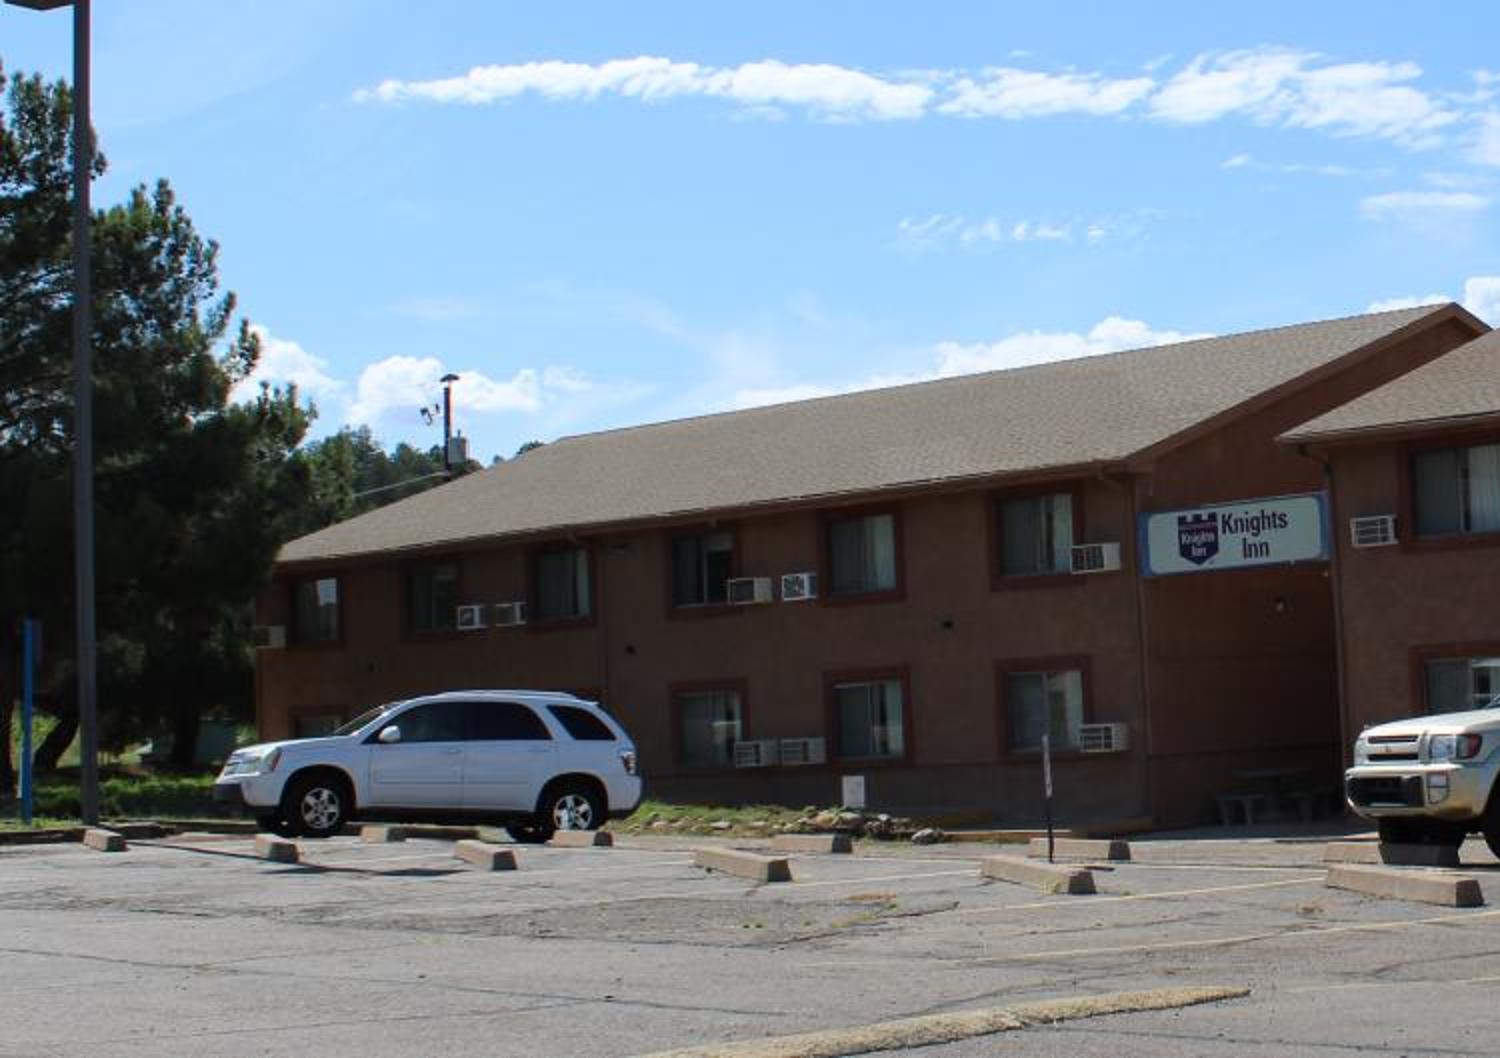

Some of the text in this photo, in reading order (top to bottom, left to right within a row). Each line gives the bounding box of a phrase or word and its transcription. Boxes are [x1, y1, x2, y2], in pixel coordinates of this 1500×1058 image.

[1221, 509, 1288, 536] Knights
[1180, 531, 1215, 545] Knights
[1192, 546, 1207, 557] Inn
[1243, 537, 1270, 559] Inn
